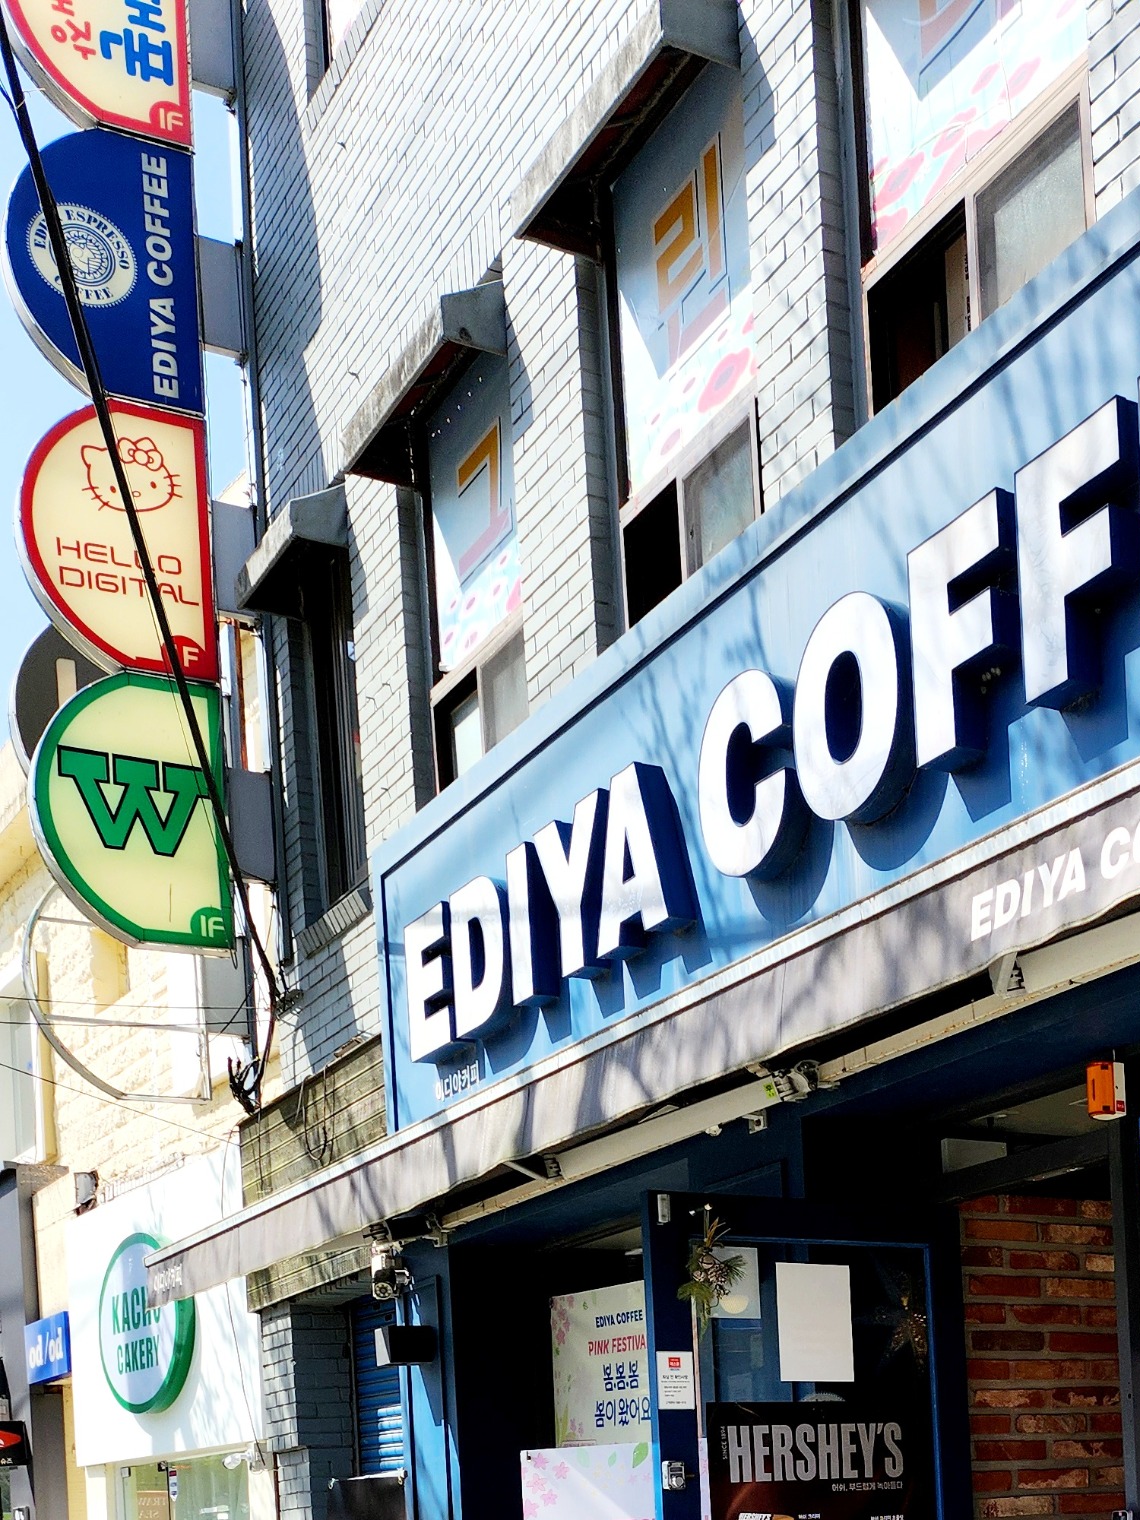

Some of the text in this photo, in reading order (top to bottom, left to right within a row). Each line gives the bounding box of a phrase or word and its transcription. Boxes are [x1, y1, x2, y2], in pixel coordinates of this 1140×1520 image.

[65, 209, 130, 270] ESPRESSO
[141, 152, 179, 400] EDIYA COFFEE
[56, 536, 182, 575] HELLO
[58, 565, 200, 606] DIGITAL
[404, 762, 684, 1062] EDIYA
[970, 847, 1086, 942] EDIYA
[435, 1060, 480, 1102] 이디야커피
[595, 1309, 643, 1328] EDIYA COFFEE
[117, 1335, 160, 1375] CAKERY
[588, 1334, 647, 1356] PINK FESTIVA
[594, 1396, 651, 1428] 봄이 왔어요
[727, 1421, 904, 1484] HERSHEY'S
[849, 1482, 876, 1491] 부드럽게
